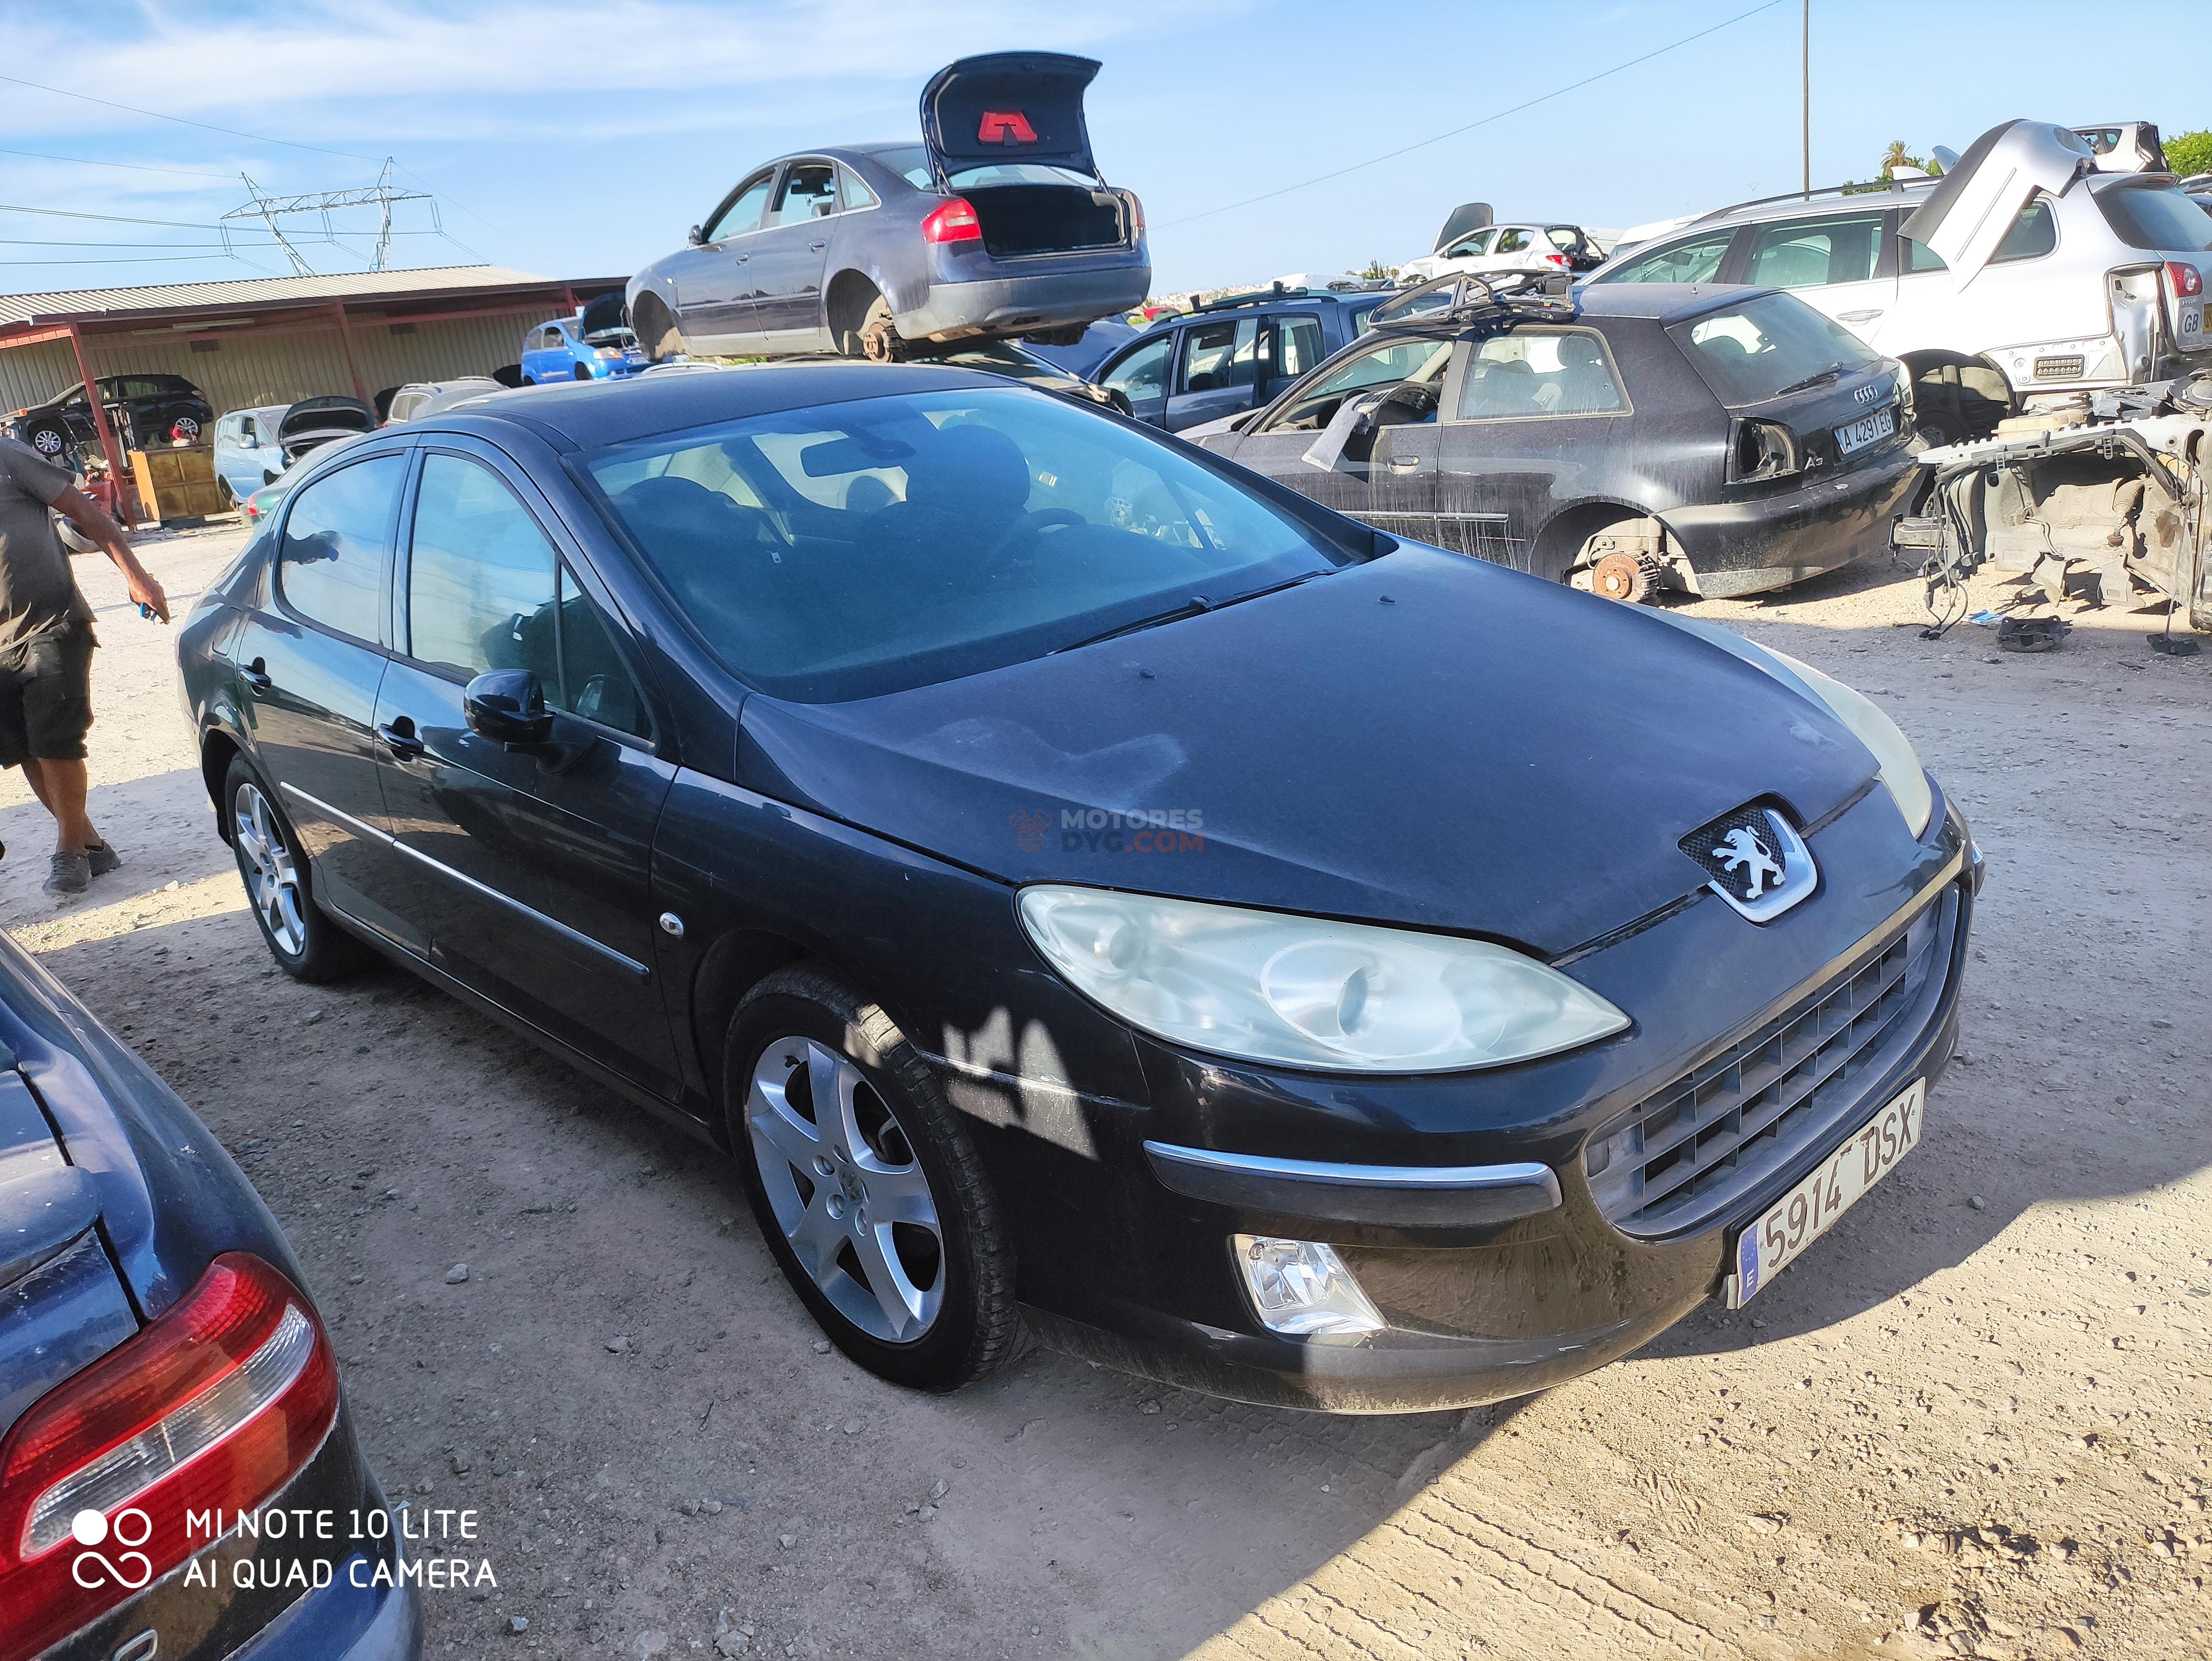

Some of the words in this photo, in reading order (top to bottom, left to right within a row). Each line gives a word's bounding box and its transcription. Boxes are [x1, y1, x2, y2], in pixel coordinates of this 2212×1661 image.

[2184, 313, 2199, 333] GB
[1844, 428, 1852, 449] A
[1855, 416, 1879, 443] 4291
[1879, 411, 1891, 433] EG
[1804, 456, 1823, 470] A3
[1766, 1159, 1842, 1268] 5914
[1863, 1093, 1916, 1185] DSX
[1746, 1269, 1755, 1288] E
